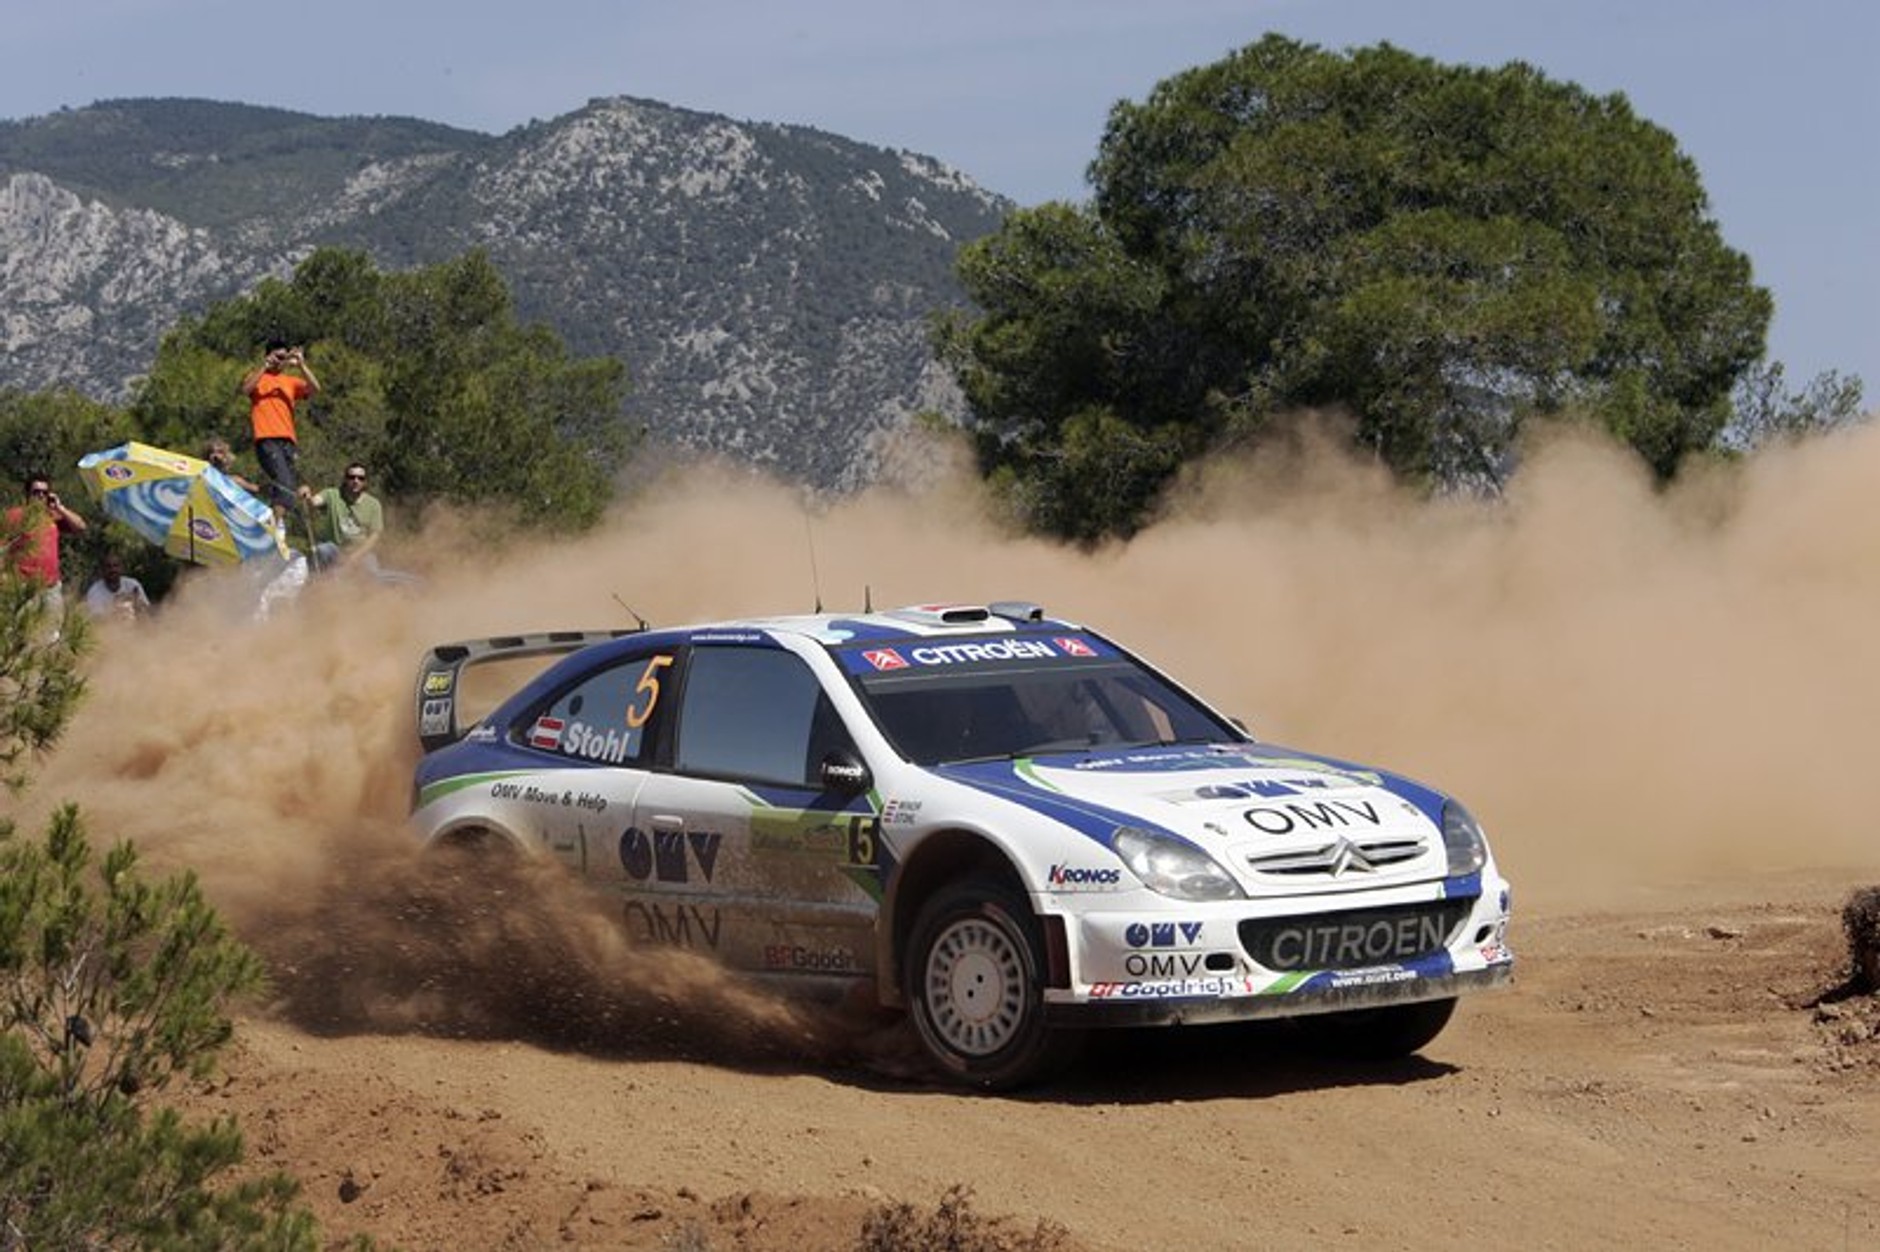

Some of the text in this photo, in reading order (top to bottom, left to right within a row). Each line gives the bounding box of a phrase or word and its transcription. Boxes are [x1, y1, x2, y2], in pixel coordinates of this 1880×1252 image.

[627, 655, 674, 728] 5
[564, 722, 629, 763] Stohl
[524, 787, 557, 804] Move
[561, 790, 572, 806] &
[576, 792, 607, 814] Help
[1243, 801, 1380, 834] OMV
[857, 818, 873, 864] 5
[1048, 864, 1120, 884] KRONOS
[1125, 954, 1202, 976] OMV
